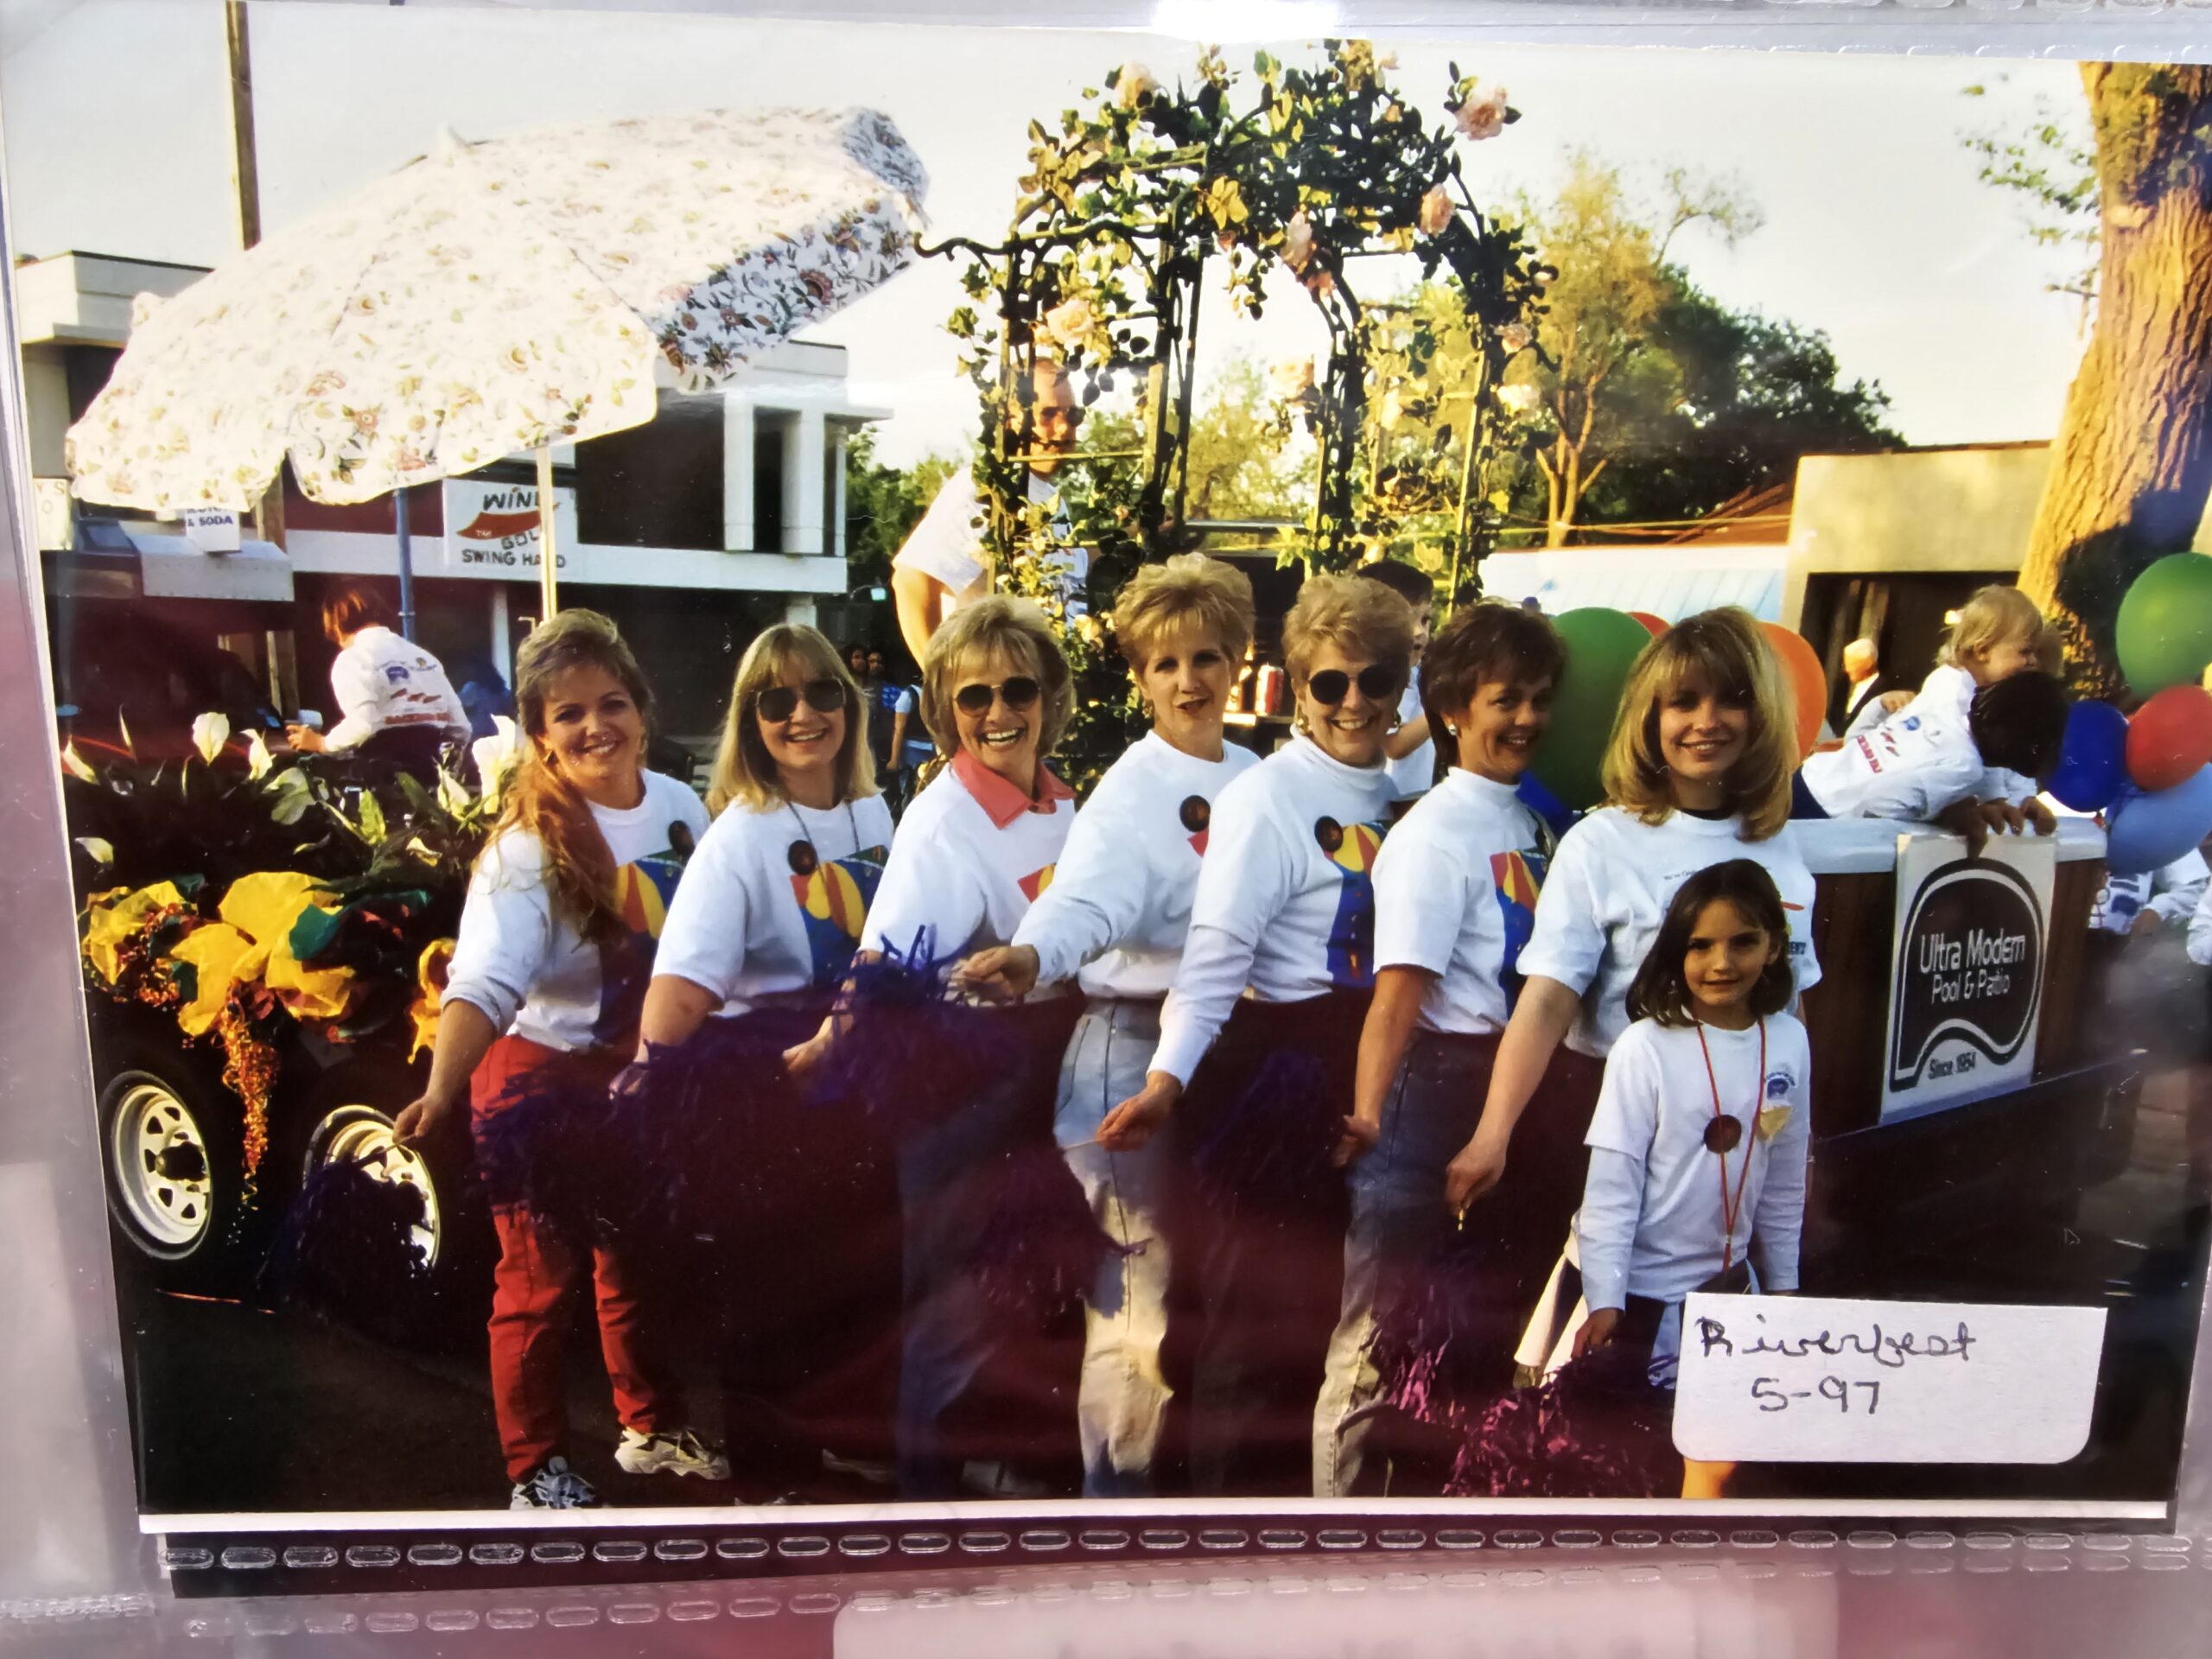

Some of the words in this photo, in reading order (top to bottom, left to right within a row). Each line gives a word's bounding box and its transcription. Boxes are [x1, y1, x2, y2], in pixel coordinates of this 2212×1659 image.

[199, 515, 233, 526] SODA
[501, 530, 540, 550] GOL
[461, 549, 517, 565] SWING
[522, 553, 567, 569] HAD
[1920, 932, 1962, 974] Ultra
[1966, 927, 2026, 968] Modern
[1930, 973, 1961, 1005] Pool
[1963, 970, 1975, 1000] &
[1976, 968, 2011, 999] Patio
[1928, 1058, 1954, 1079] Since
[1694, 1313, 1978, 1368] Riverfest
[1750, 1376, 1881, 1414] 5-97
